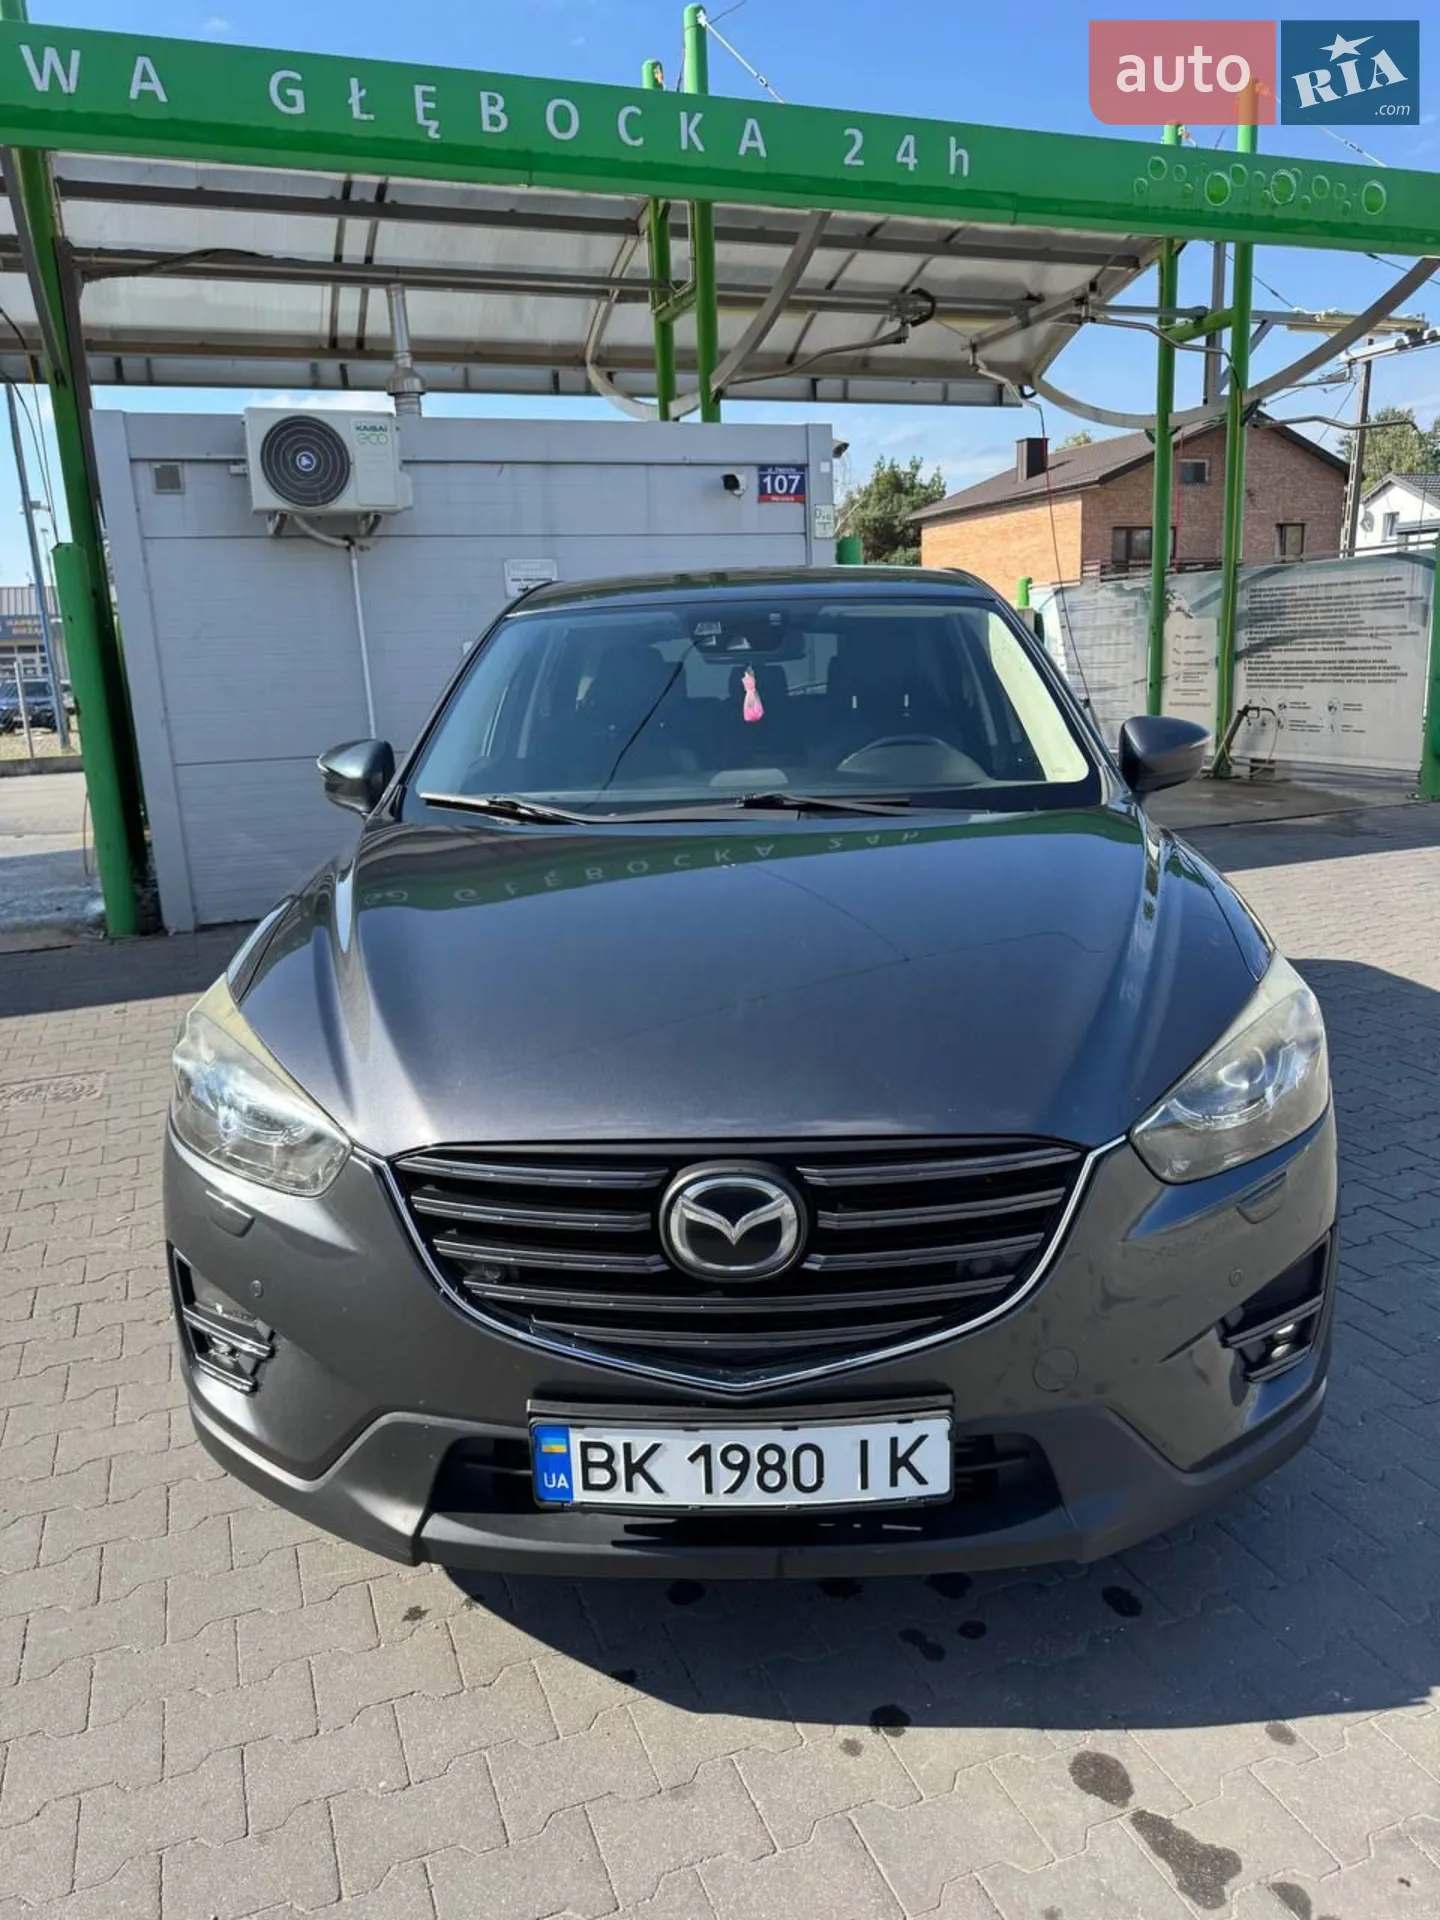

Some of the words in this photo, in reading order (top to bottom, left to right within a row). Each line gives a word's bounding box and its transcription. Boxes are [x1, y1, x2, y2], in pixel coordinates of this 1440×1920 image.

[20, 43, 168, 103] WA
[269, 69, 767, 159] GŁĘBOCKA
[842, 127, 970, 178] 24h
[762, 474, 801, 494] 107
[543, 1472, 569, 1490] UA
[579, 1440, 664, 1494] BK
[687, 1443, 824, 1495] 1980
[858, 1434, 929, 1491] IK
